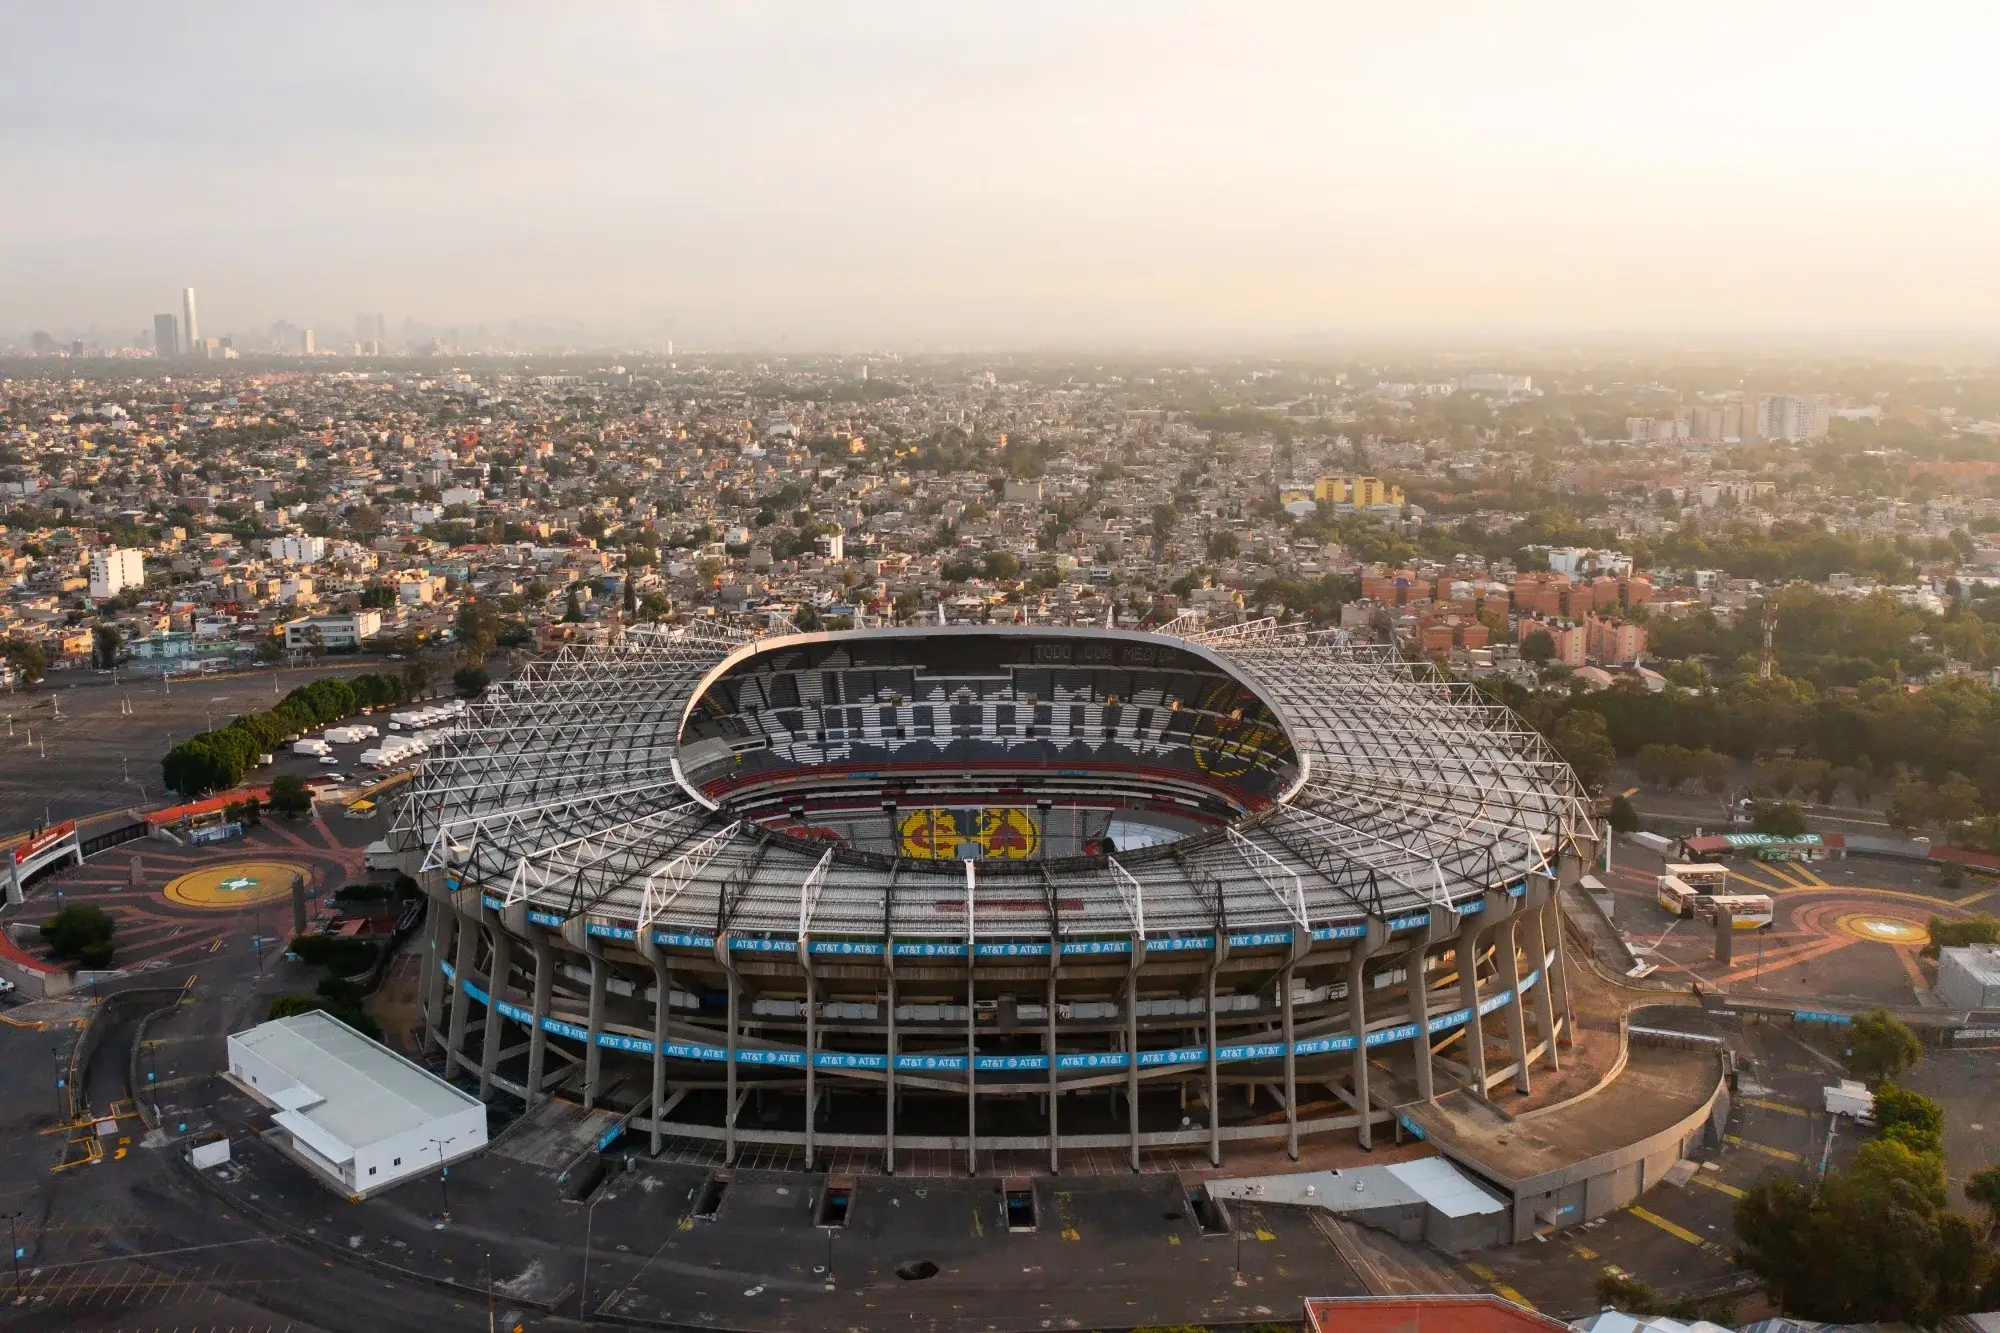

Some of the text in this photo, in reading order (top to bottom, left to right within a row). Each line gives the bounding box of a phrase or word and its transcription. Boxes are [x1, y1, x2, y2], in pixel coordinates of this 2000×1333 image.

[1035, 645, 1071, 659] TODO
[1464, 903, 1480, 913] AT&T
[531, 913, 548, 924] AT&T
[1408, 916, 1426, 927] AT&T
[591, 926, 634, 939] AT&T AT
[1311, 926, 1360, 939] T&T AT&T
[658, 935, 680, 944] AT&T
[1146, 939, 1208, 949] AT&T AT&T
[1263, 935, 1286, 944] AT&T
[736, 941, 797, 951] AT&T AT&T
[815, 944, 877, 953] AT&T AT&T
[898, 946, 960, 954] AT&T AT&T
[981, 946, 1043, 954] AT&T AT&T
[1064, 943, 1126, 953] AT&T AT&T
[1452, 1012, 1469, 1022] AT&T
[544, 1020, 588, 1040] AT&T AT&T
[1366, 1028, 1415, 1044] AT&T AT&T
[599, 1036, 653, 1051] AT&T AT&T
[1296, 1038, 1352, 1052] AT&T AT&T
[667, 1045, 725, 1059] AT&T AT&T
[1142, 1051, 1202, 1063] AT&T AT&T
[1220, 1045, 1280, 1058] AT&T AT&T
[741, 1052, 801, 1063] AT&T AT&T
[820, 1056, 882, 1066] AT&T AT&T
[900, 1058, 961, 1067] AT&T AT&T
[981, 1058, 1042, 1068] AT&T AT&T
[1061, 1055, 1123, 1066] AT&T AT&T
